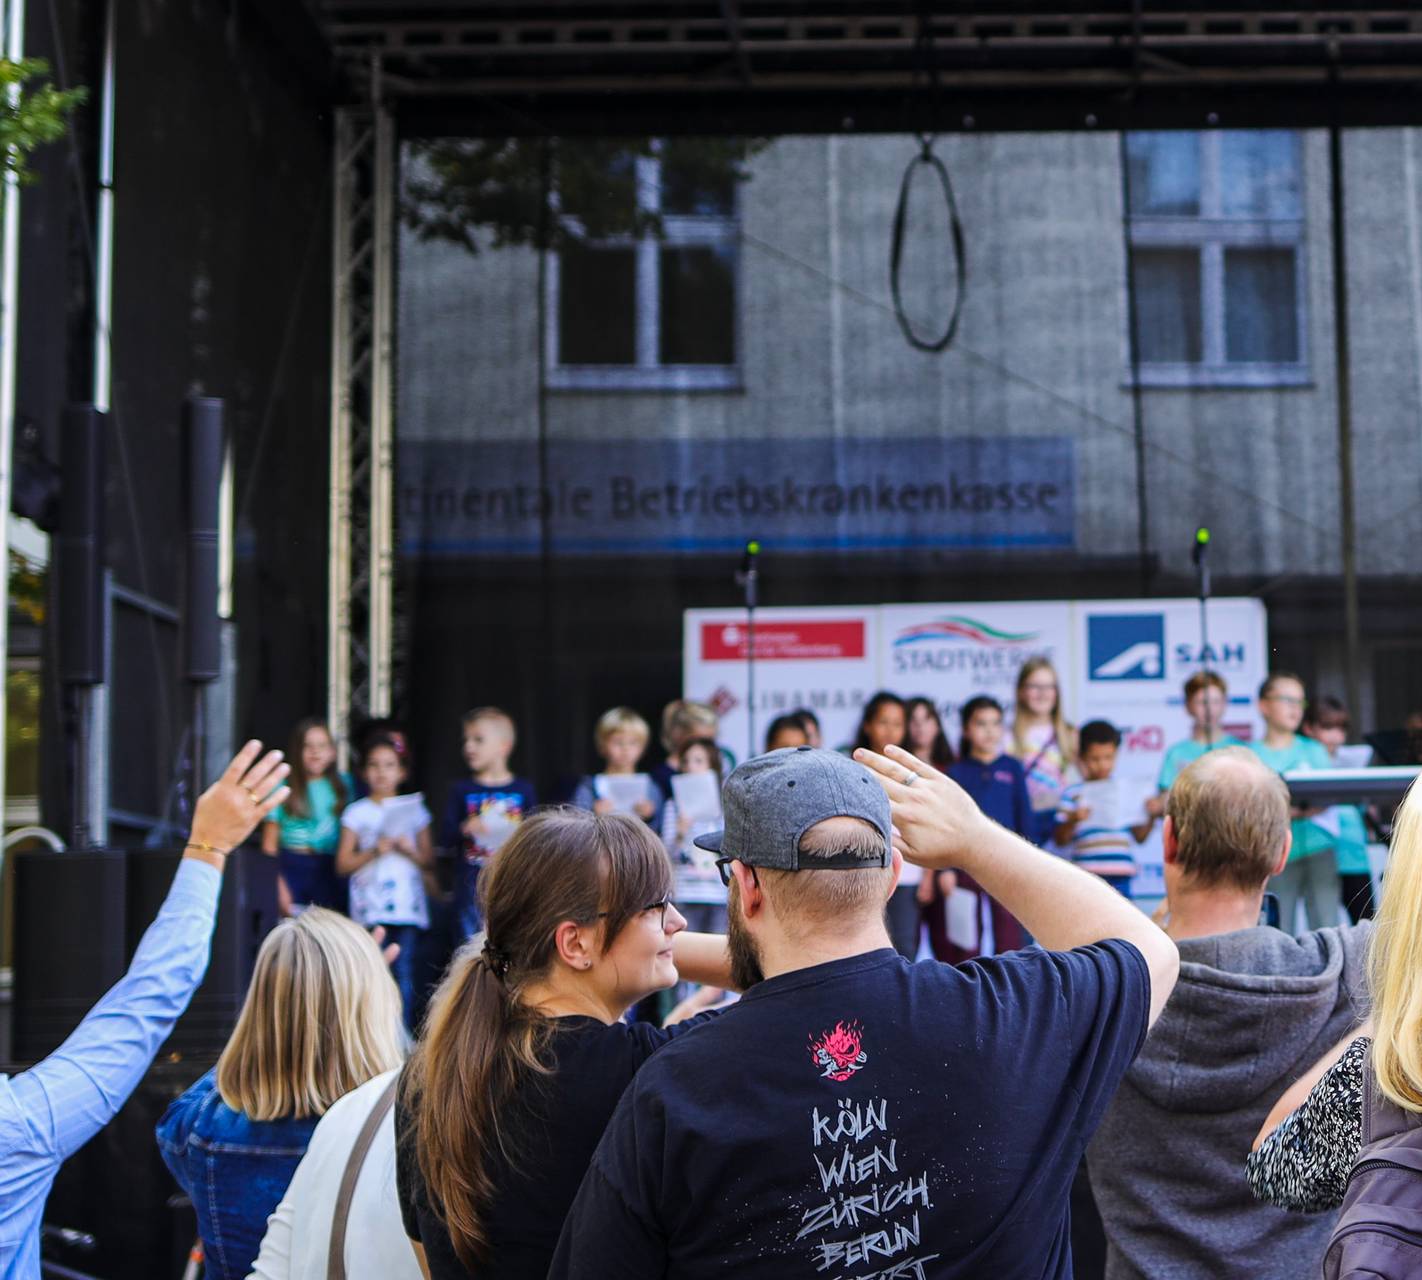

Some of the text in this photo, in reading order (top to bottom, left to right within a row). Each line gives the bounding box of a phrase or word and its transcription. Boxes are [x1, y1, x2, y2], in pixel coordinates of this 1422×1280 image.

[610, 474, 1058, 519] Betriebskrankenkasse
[1176, 643, 1244, 663] SAH
[812, 1098, 887, 1146] KÖLN
[811, 1210, 920, 1271] BERLIN
